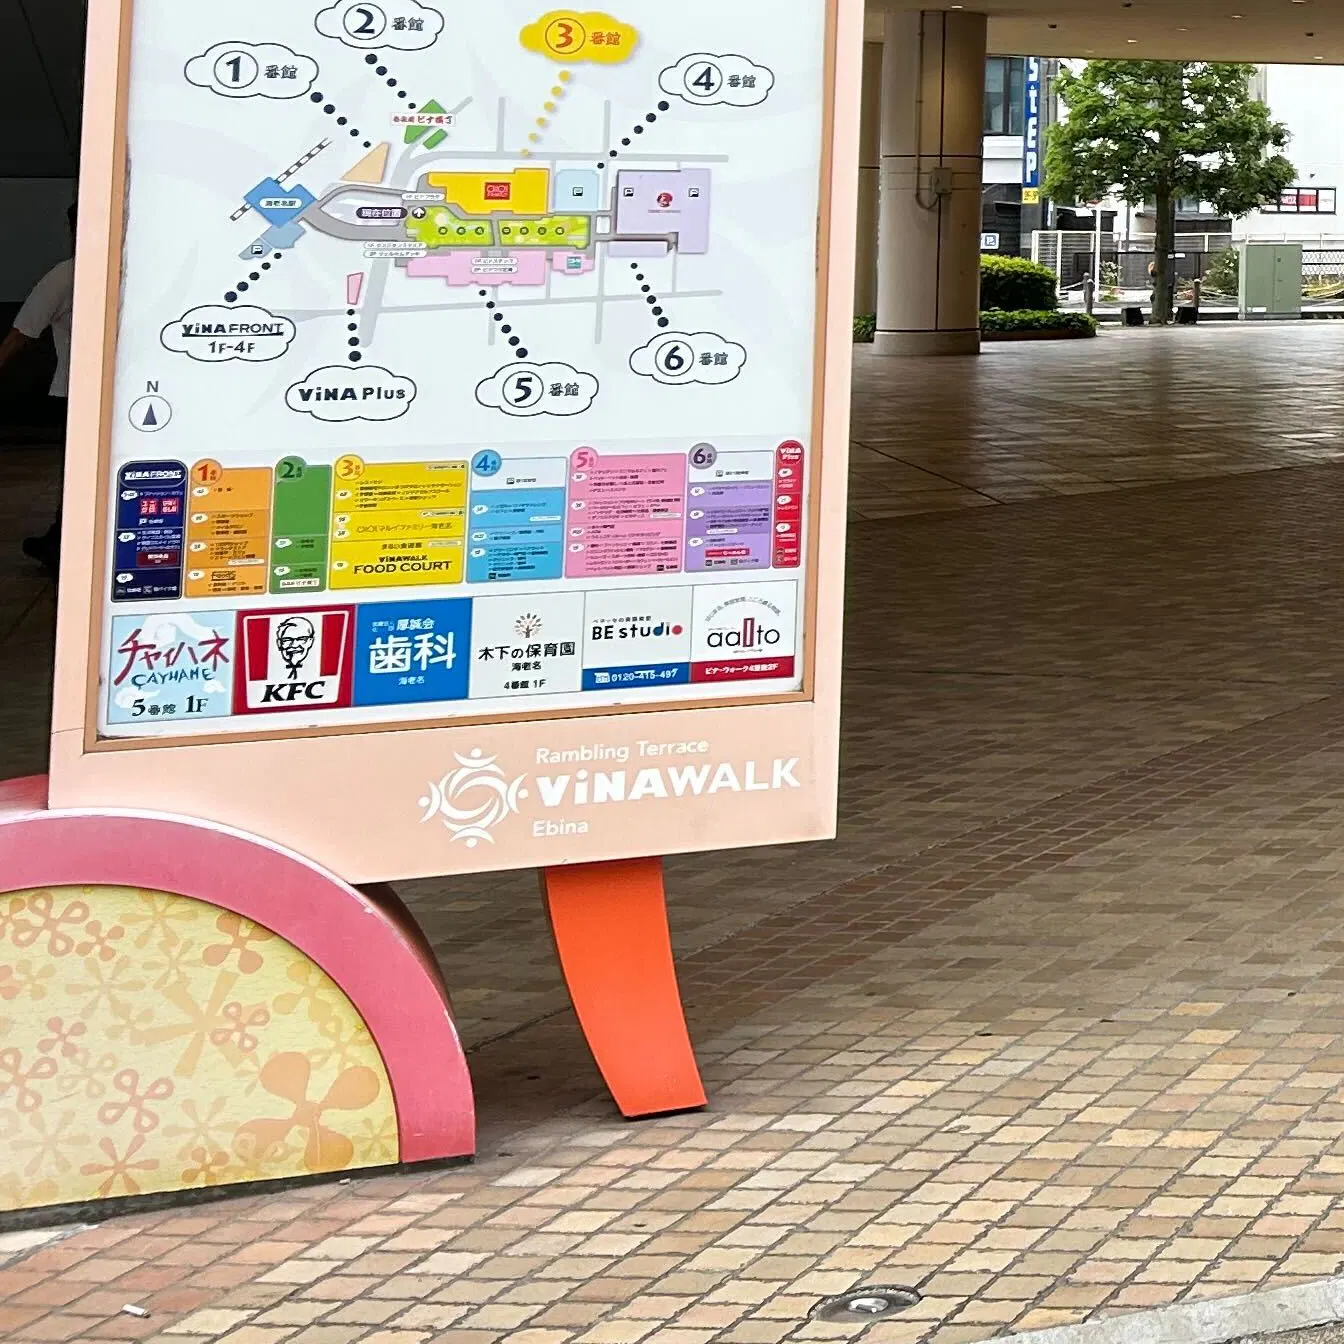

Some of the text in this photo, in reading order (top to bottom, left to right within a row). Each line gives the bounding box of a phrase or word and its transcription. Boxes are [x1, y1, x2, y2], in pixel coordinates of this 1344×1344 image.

[353, 7, 375, 34] 2
[556, 22, 573, 49] 3
[225, 56, 242, 83] 1
[692, 66, 715, 91] 4
[208, 341, 255, 354] 1F-4F
[664, 345, 684, 371] 6
[146, 380, 159, 393] N
[362, 386, 406, 400] Plus
[514, 376, 533, 403] 5
[354, 560, 452, 574] FOOD COURT
[592, 622, 683, 640] BE studio
[114, 628, 230, 686] チャイハネ
[368, 632, 457, 674] 歯科
[478, 641, 576, 662] 木下の保育園
[511, 661, 542, 672] 海老名
[398, 676, 425, 686] 海老名
[533, 678, 547, 688] 1F
[261, 681, 327, 703] KFC
[185, 695, 209, 713] 1F
[535, 739, 711, 765] Rambling Terrace
[532, 819, 589, 838] Ebina
